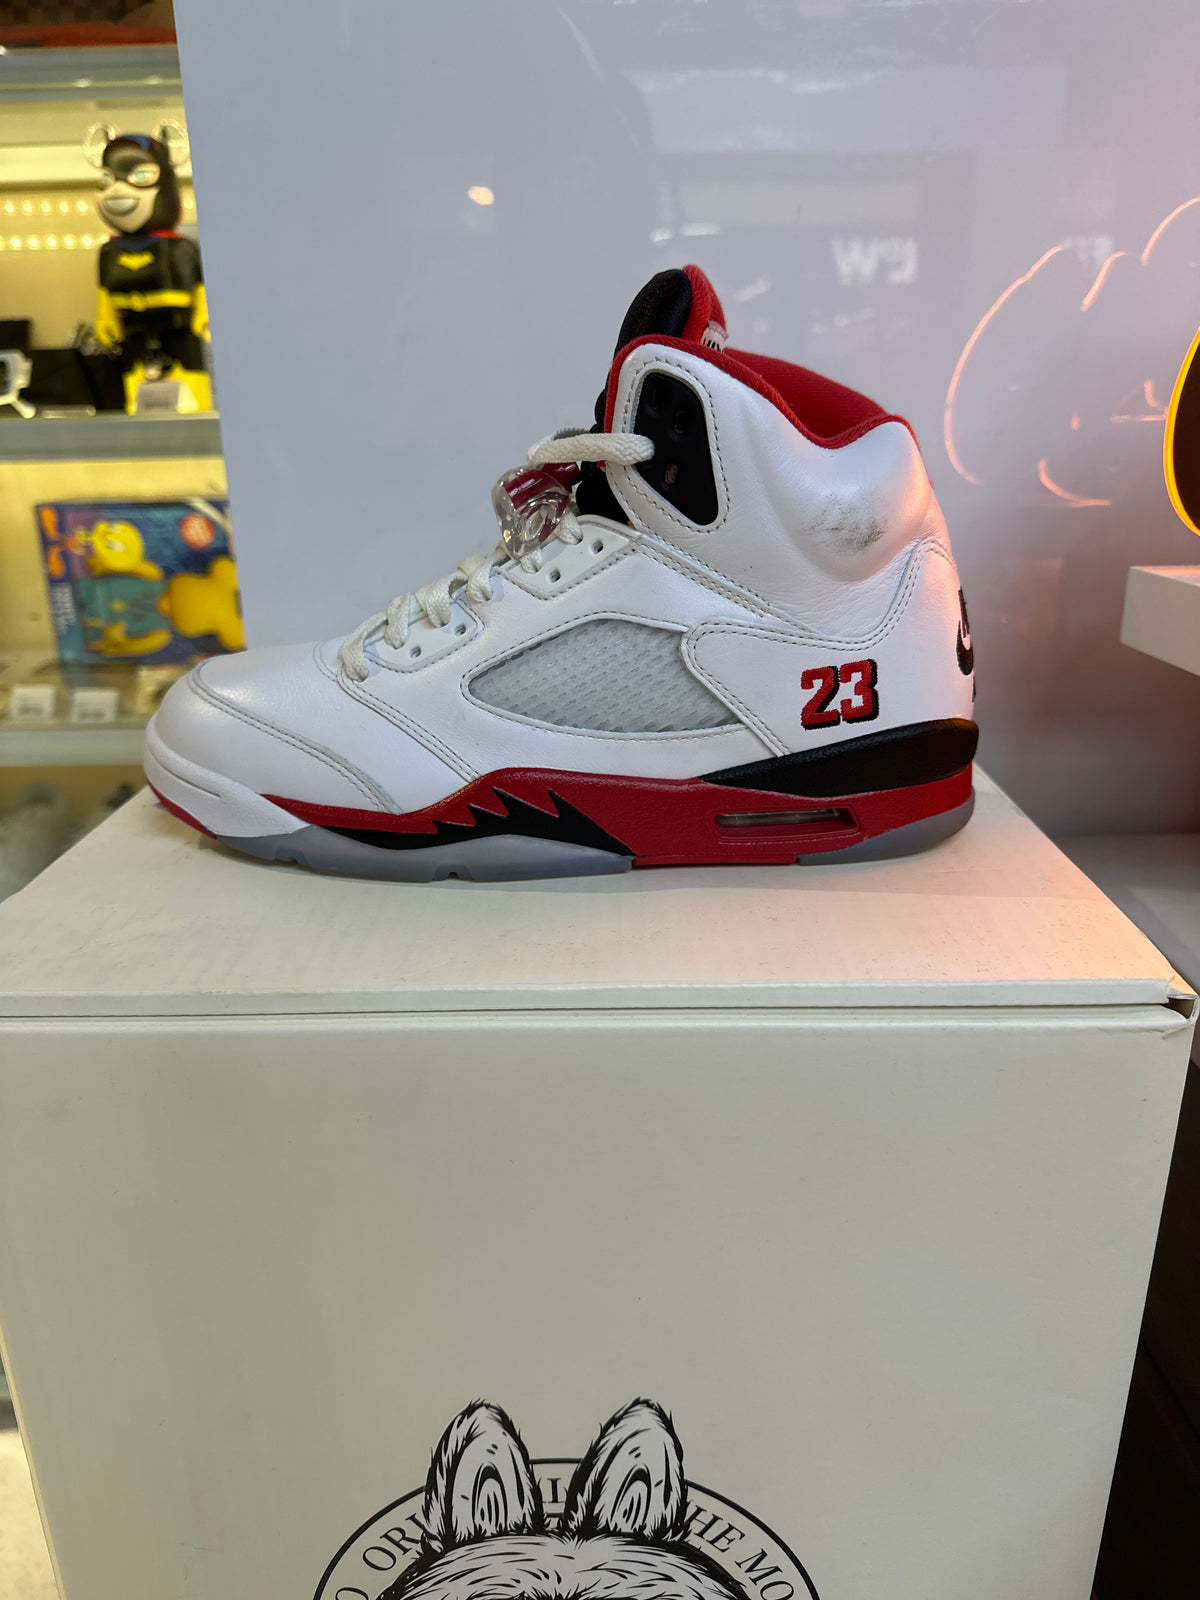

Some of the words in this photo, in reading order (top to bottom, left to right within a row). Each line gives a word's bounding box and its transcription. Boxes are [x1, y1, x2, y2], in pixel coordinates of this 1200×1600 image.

[801, 658, 879, 730] 23
[684, 1504, 746, 1553] HE
[734, 1548, 795, 1600] MO
